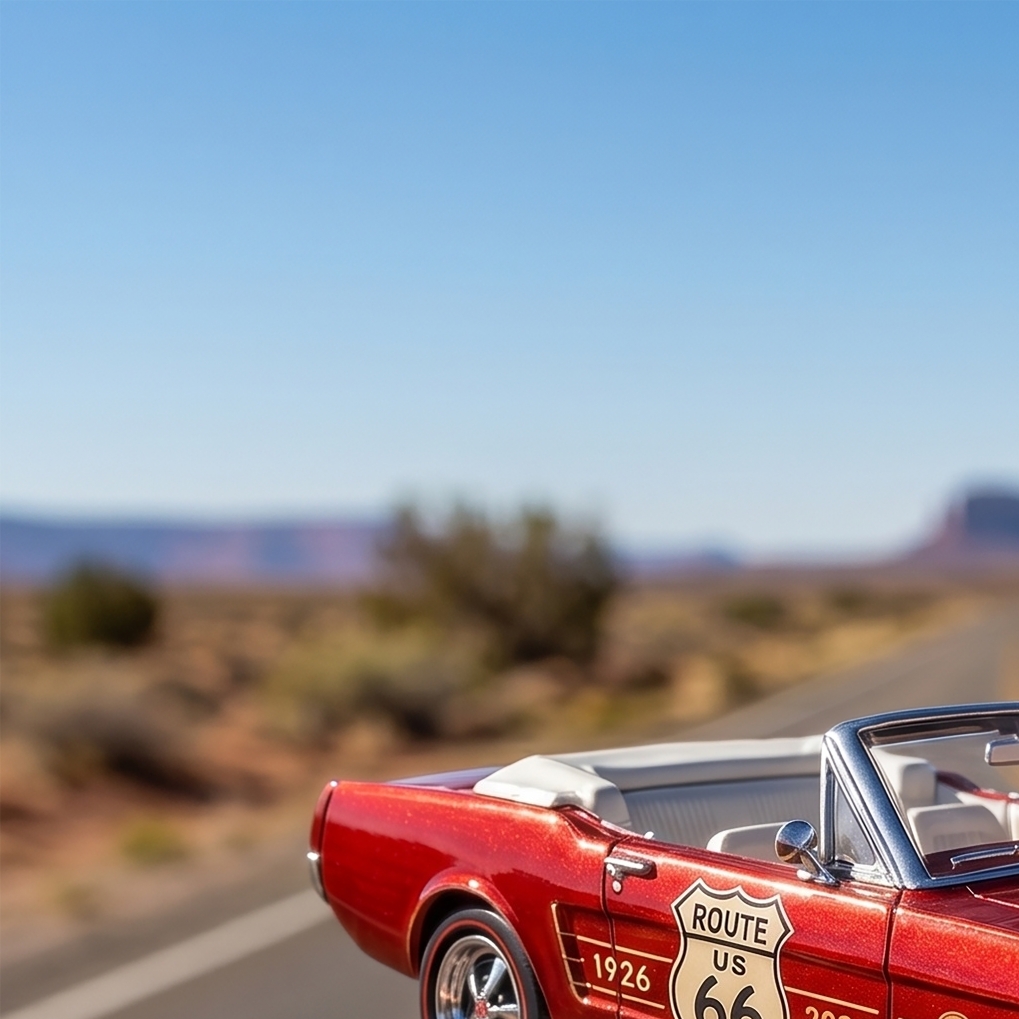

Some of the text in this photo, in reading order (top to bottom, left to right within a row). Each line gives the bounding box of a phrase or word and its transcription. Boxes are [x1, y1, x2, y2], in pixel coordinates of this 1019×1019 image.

[692, 903, 768, 945] ROUTE
[593, 953, 650, 992] 1926
[713, 950, 746, 976] US
